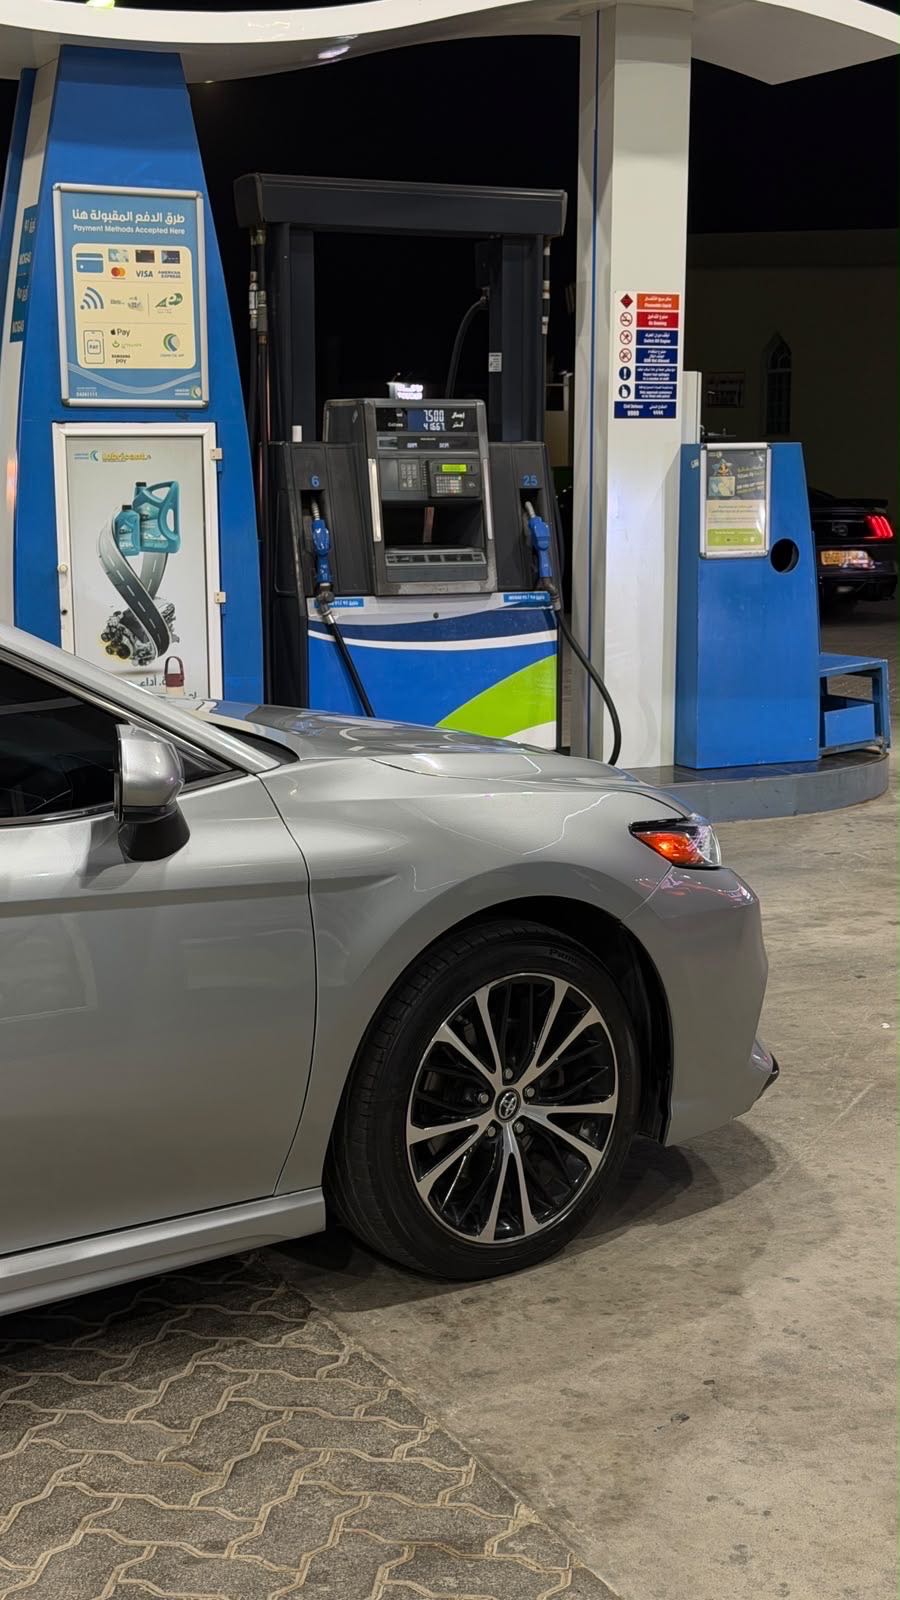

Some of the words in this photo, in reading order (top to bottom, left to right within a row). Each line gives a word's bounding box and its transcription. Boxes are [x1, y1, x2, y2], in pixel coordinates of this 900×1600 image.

[72, 208, 89, 220] هنا
[90, 209, 133, 223] المقبولة
[135, 211, 163, 224] الدفع
[164, 212, 185, 225] طرق
[73, 224, 104, 233] Payment
[105, 225, 134, 234] Methods
[135, 226, 168, 235] Accepted
[169, 227, 186, 235] Here
[136, 270, 154, 278] VISA
[116, 328, 131, 337] Pay
[310, 475, 320, 487] 6
[523, 474, 538, 487] 25
